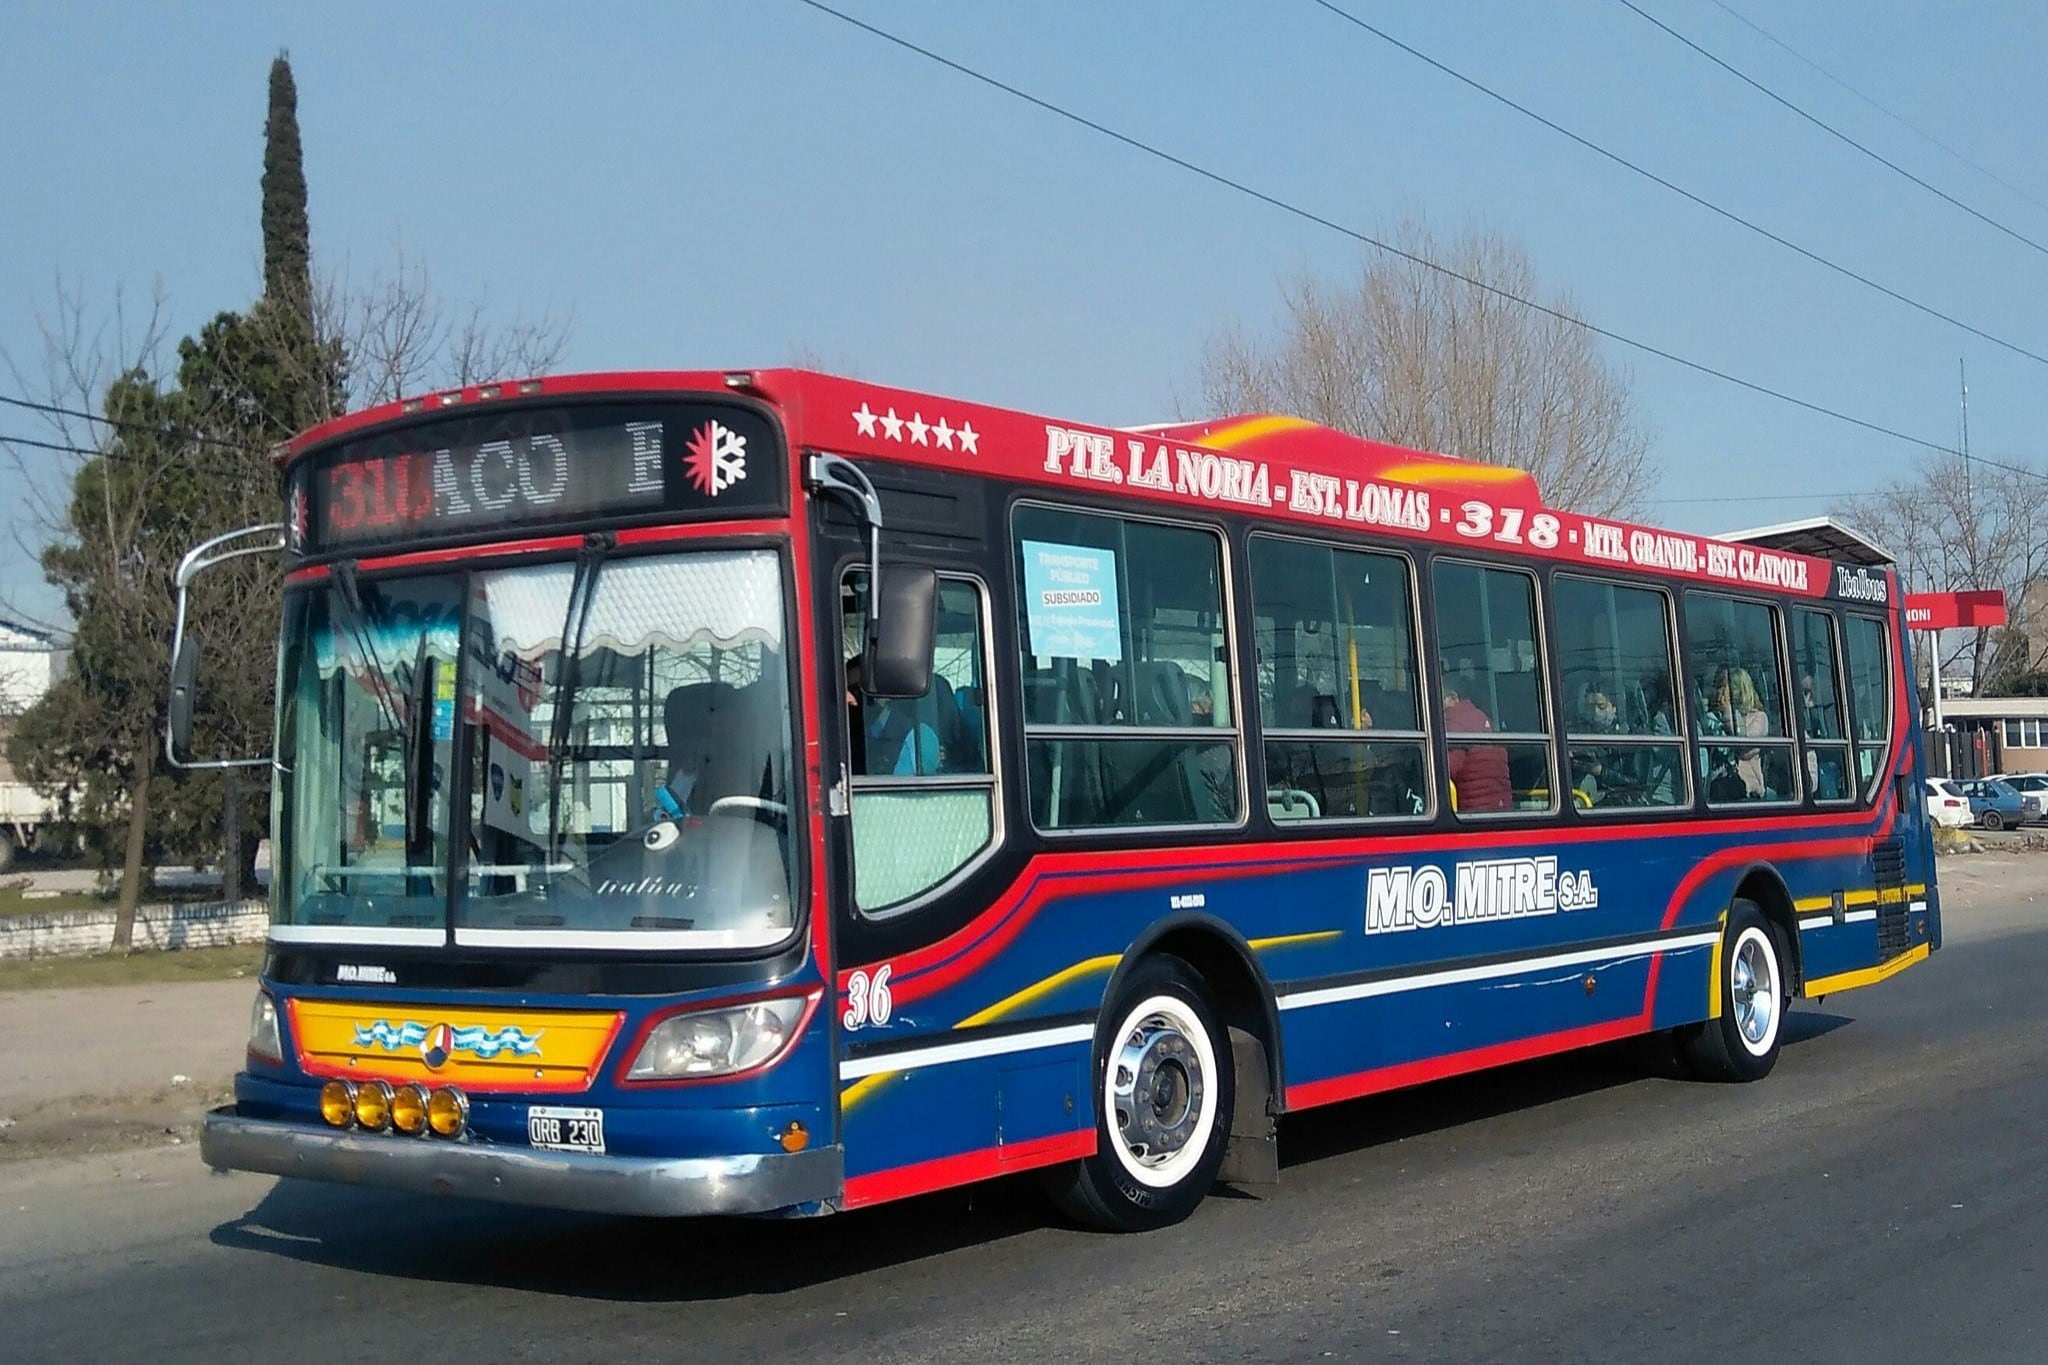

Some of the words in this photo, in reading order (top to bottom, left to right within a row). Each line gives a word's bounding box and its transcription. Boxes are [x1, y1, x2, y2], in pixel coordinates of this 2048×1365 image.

[1044, 425, 1123, 484] PTE.
[1127, 440, 1173, 492] LA
[1176, 450, 1272, 507] NORIA
[1289, 470, 1342, 519] EST.
[1346, 480, 1431, 532] LOMAS
[1456, 501, 1560, 549] 318
[1583, 521, 1628, 562] MTE.
[1630, 530, 1698, 573] GRANDE
[1739, 549, 1808, 590] CLAYPOLE
[1043, 591, 1100, 605] SUBSIDIADO
[1837, 566, 1887, 602] Italbus
[1455, 855, 1558, 925] MITRE
[1558, 869, 1599, 911] S.A.
[843, 963, 893, 1032] 36
[531, 1118, 561, 1143] ORB
[568, 1120, 600, 1145] 230
